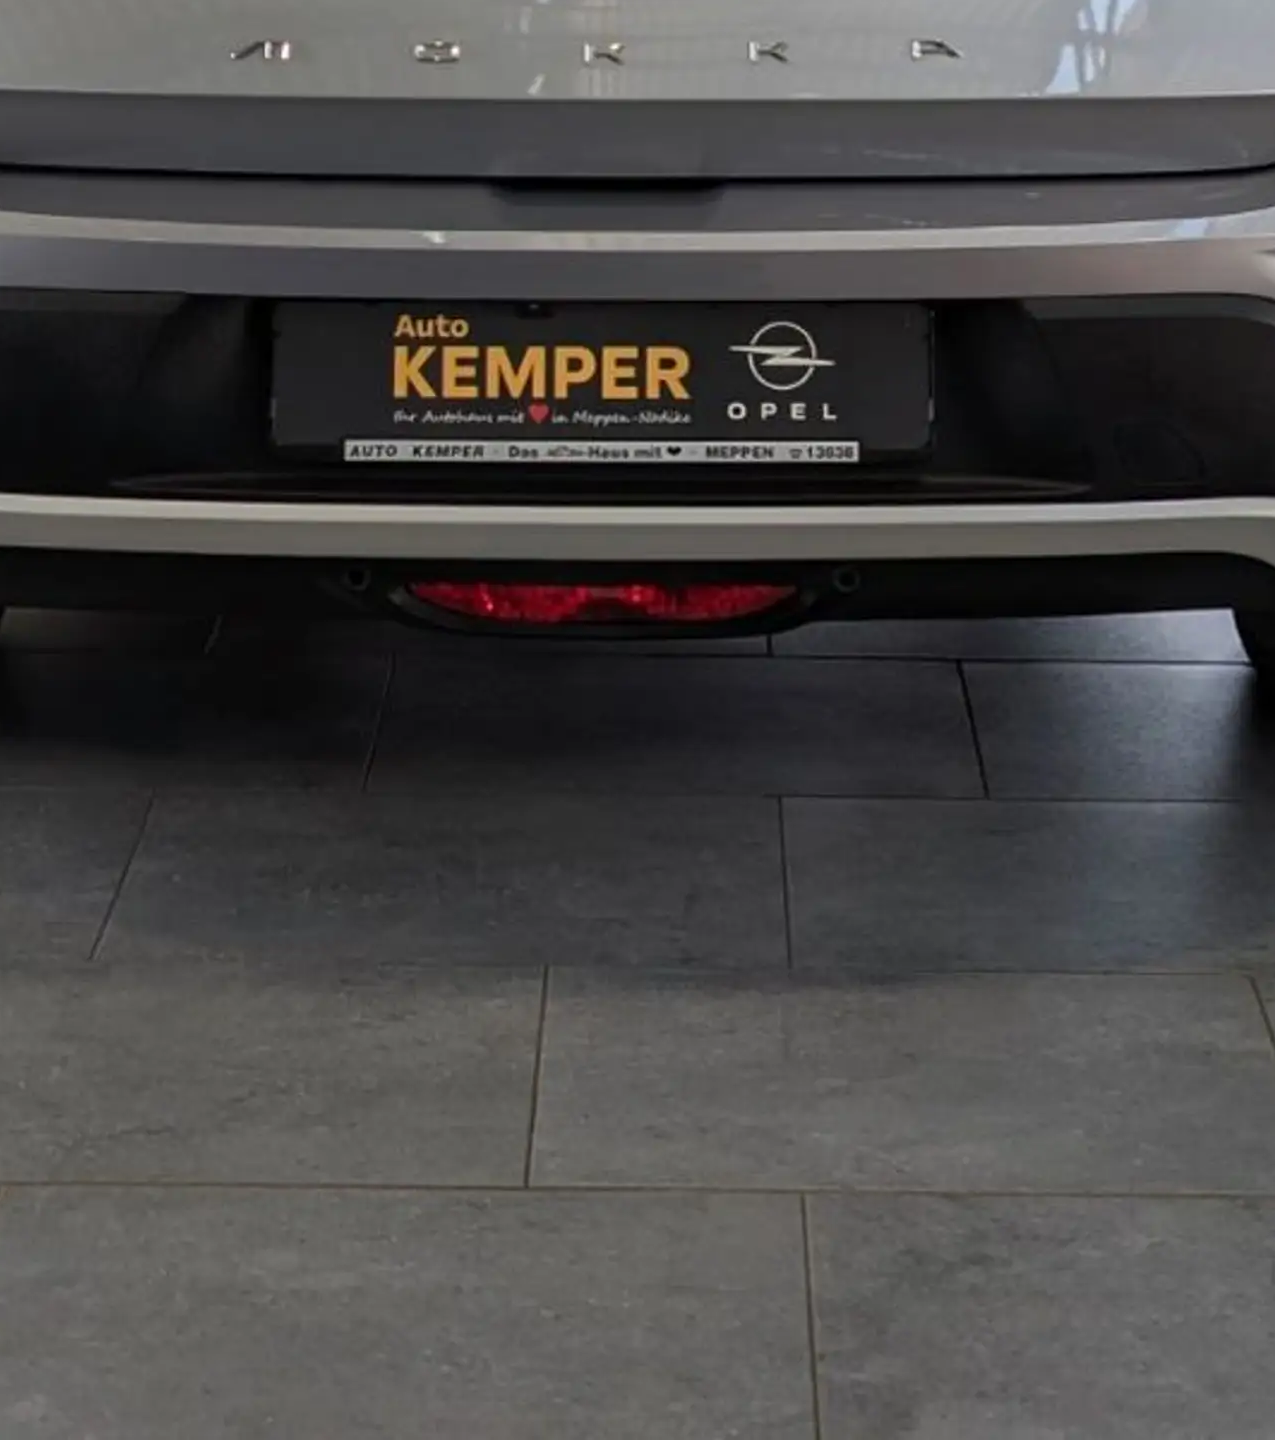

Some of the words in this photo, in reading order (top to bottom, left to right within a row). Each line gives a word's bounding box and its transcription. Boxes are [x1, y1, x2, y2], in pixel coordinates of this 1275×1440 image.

[394, 313, 470, 339] Auto
[393, 345, 692, 400] KEMPER
[496, 410, 526, 424] mit
[726, 401, 837, 420] OPEL
[349, 444, 399, 458] AUTO
[412, 444, 485, 458] KEMPER
[507, 445, 540, 459] Das
[633, 445, 662, 459] mit
[705, 446, 775, 460] MEPPEN
